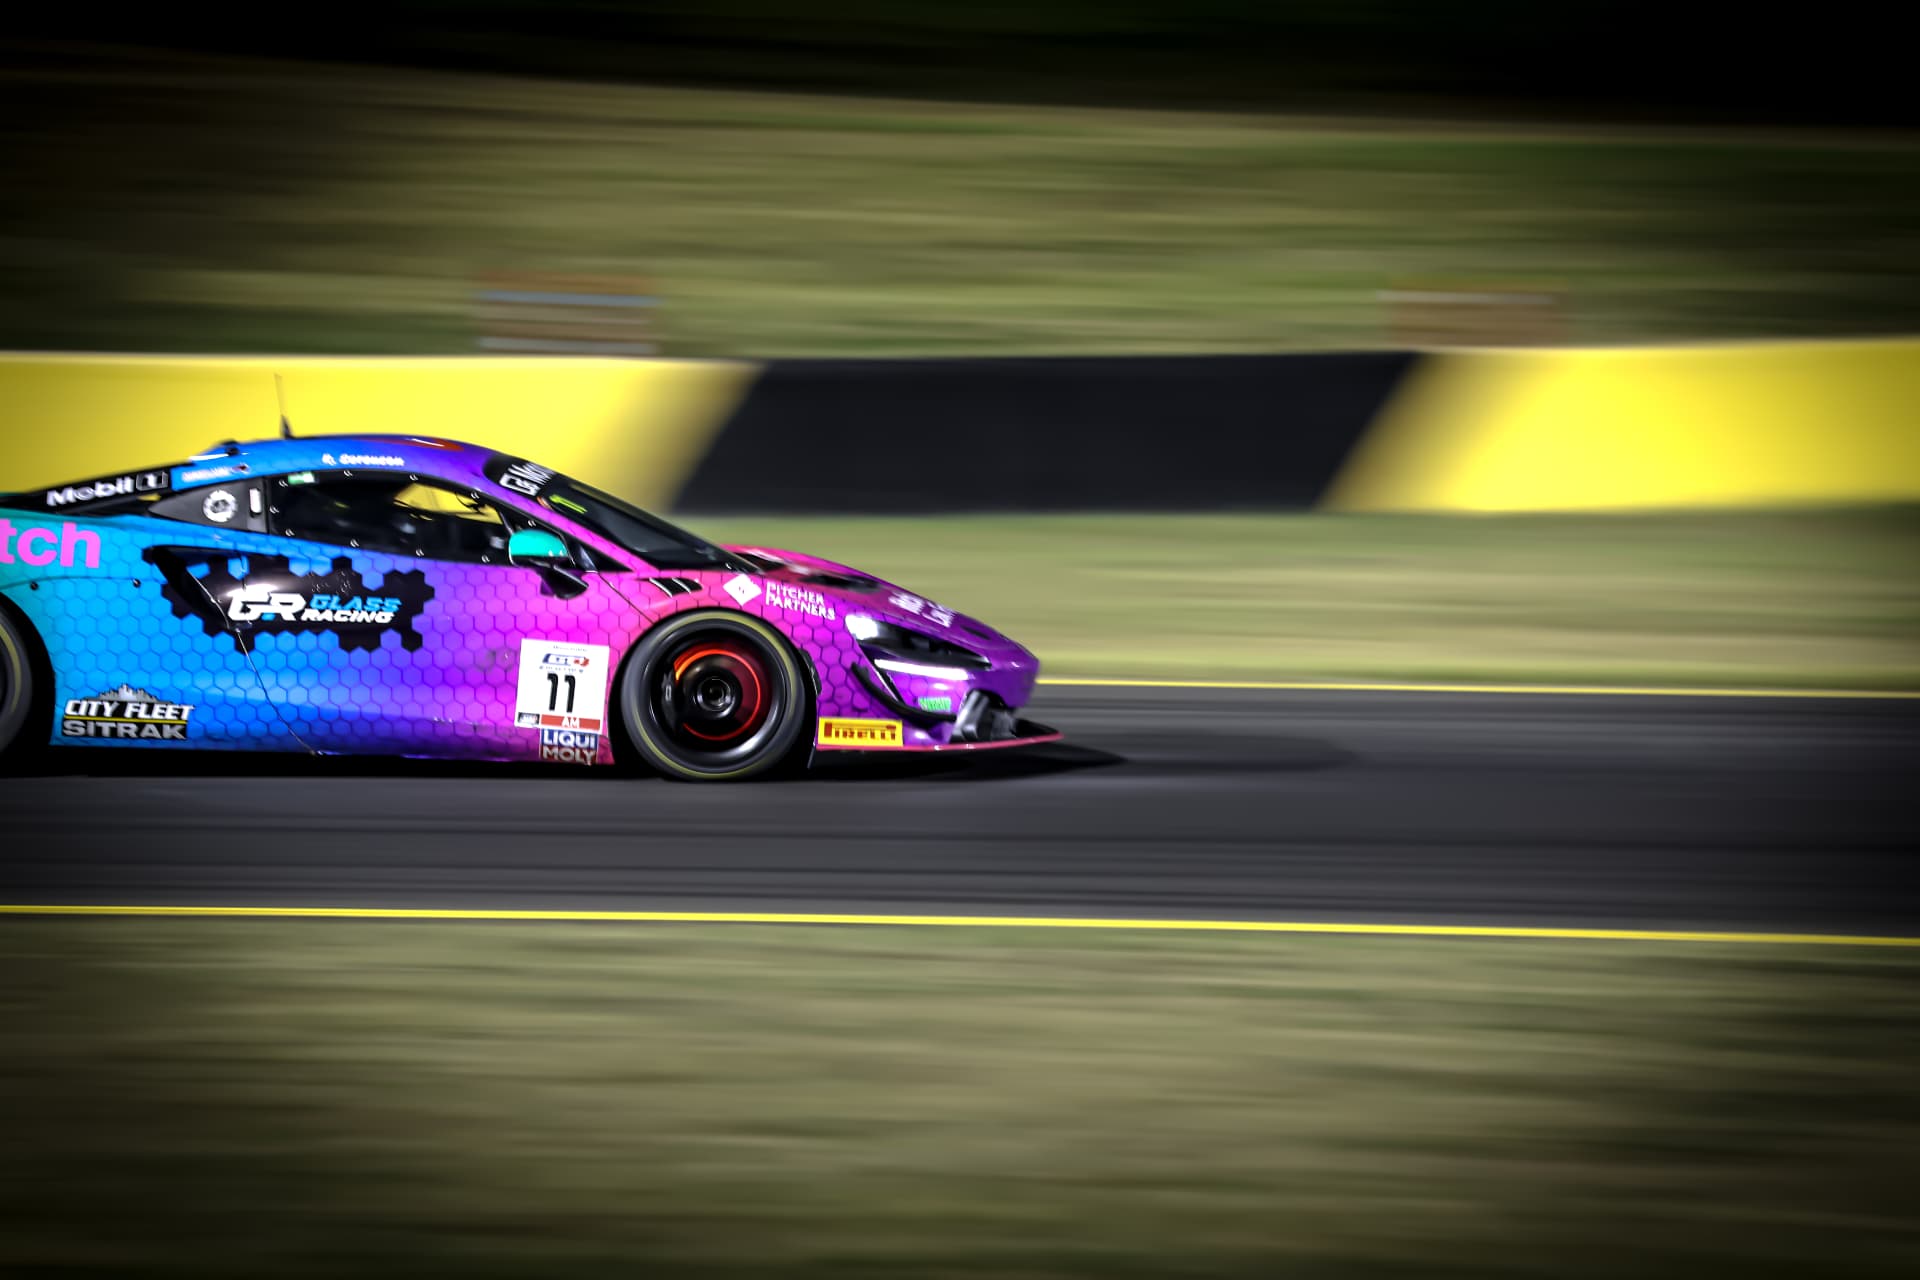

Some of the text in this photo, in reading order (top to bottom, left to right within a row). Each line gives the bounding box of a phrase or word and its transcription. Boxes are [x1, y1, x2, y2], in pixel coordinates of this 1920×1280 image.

[46, 477, 134, 506] Mobil
[0, 518, 101, 569] tch
[310, 594, 402, 612] GLASS
[766, 581, 824, 605] PITCHER
[301, 608, 395, 623] RACING
[766, 590, 835, 620] PARTNERS
[546, 672, 576, 713] 11
[65, 699, 195, 720] CITY FLEET
[62, 719, 186, 740] SITRAK
[561, 716, 580, 728] AM
[543, 728, 596, 750] LIQUI
[542, 744, 596, 766] MOLY
